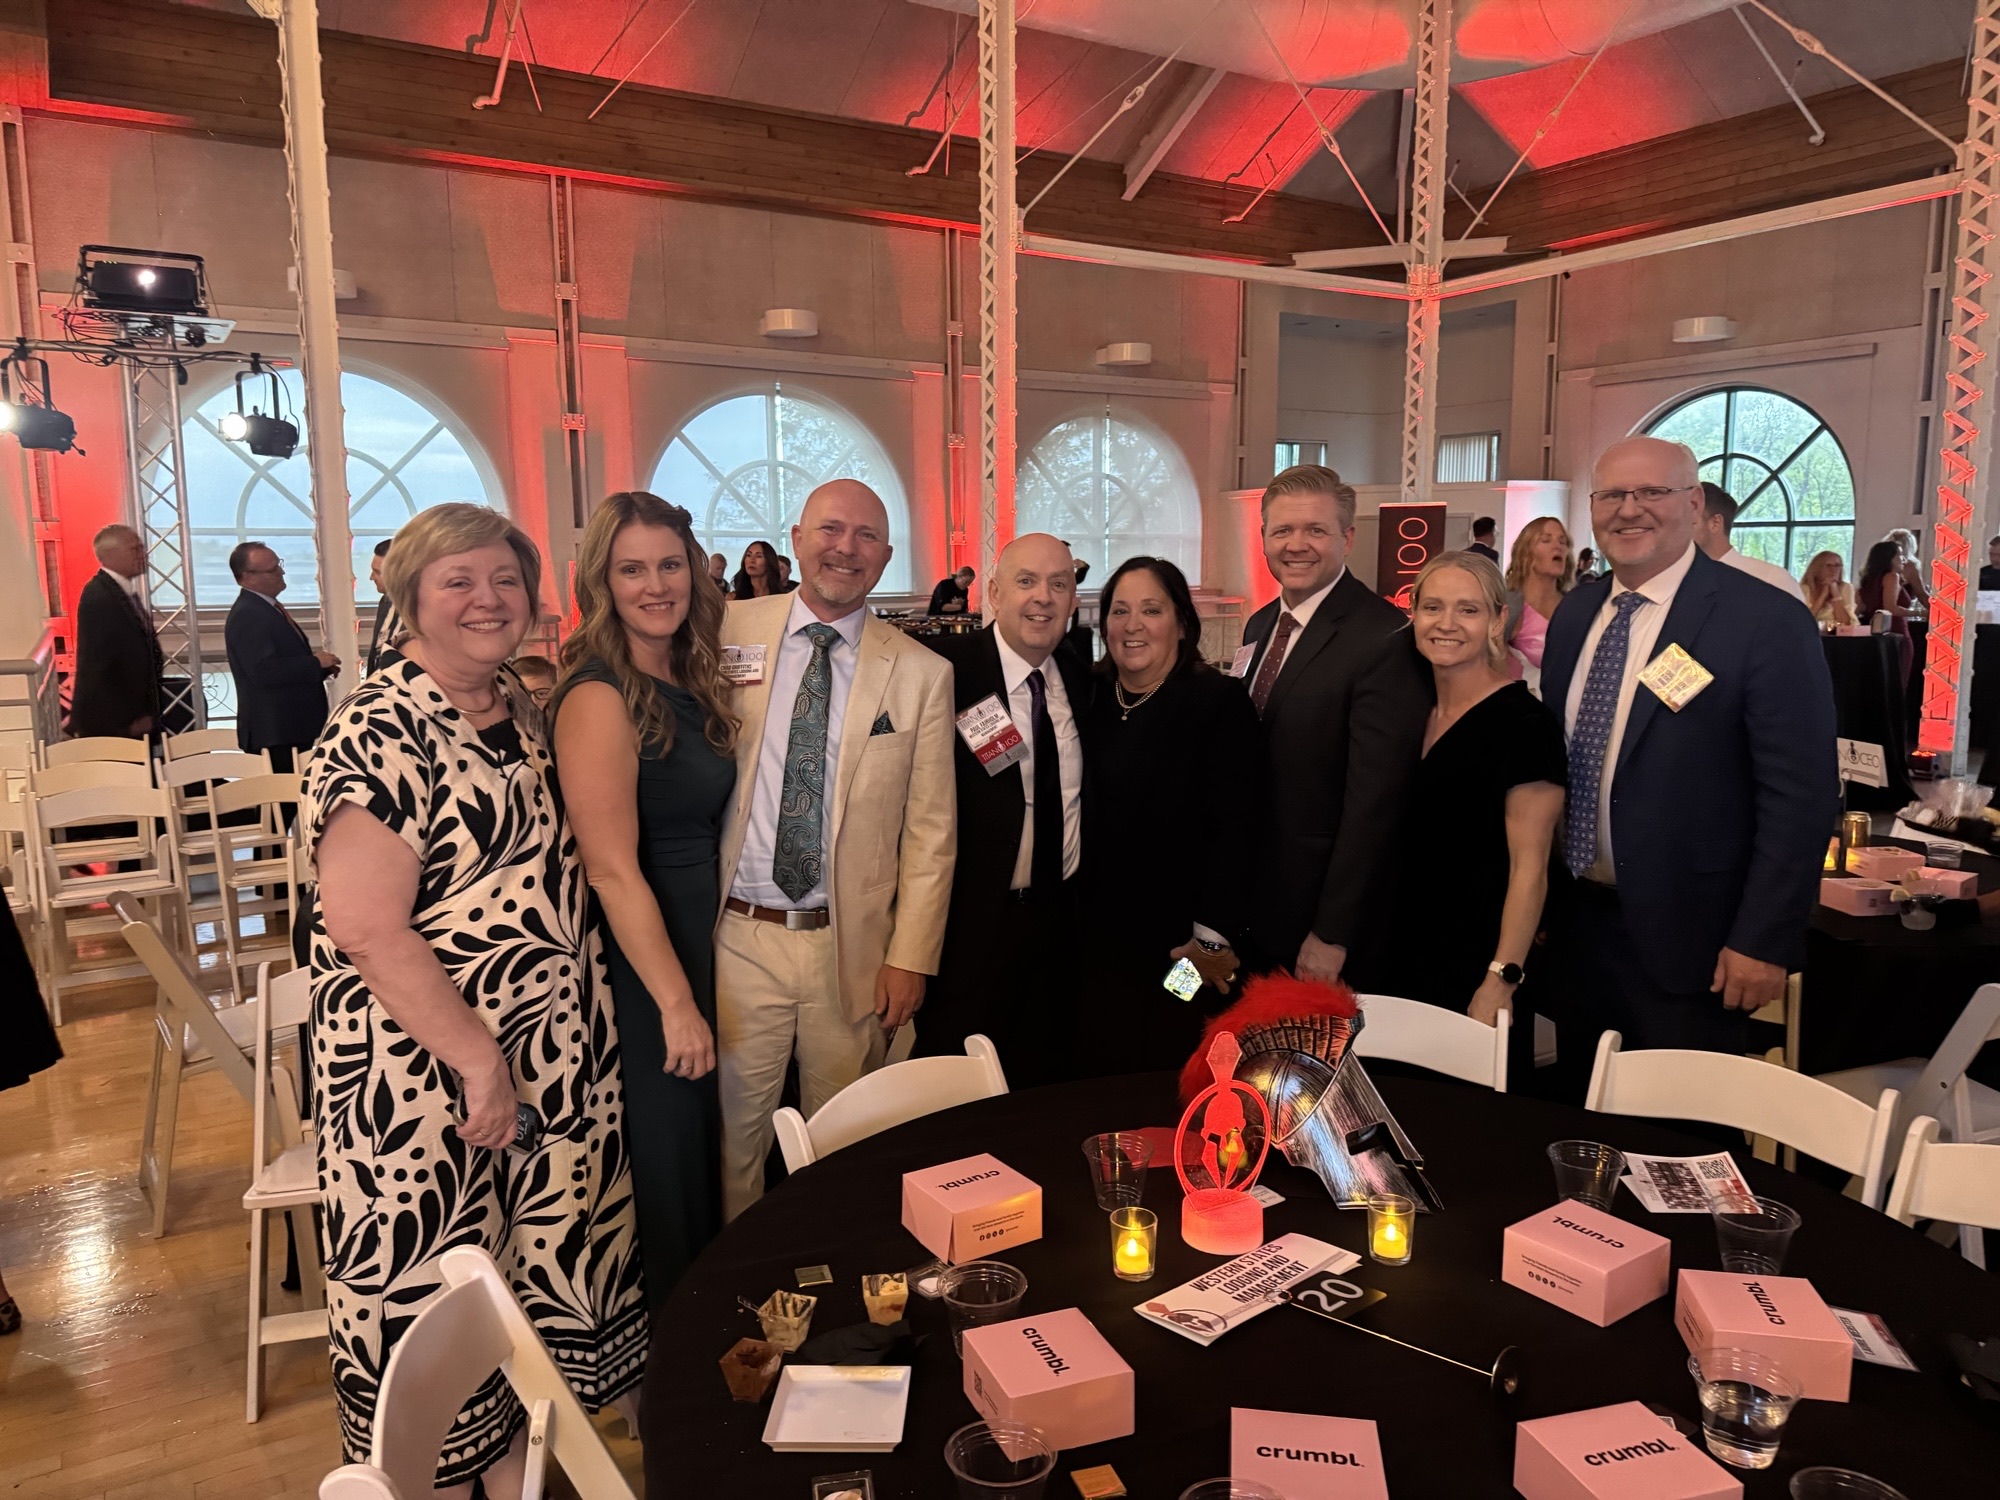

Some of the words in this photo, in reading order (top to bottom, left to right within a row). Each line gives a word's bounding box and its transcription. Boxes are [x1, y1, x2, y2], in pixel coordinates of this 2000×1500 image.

[1397, 517, 1428, 574] 100
[746, 652, 762, 661] 100
[986, 701, 1000, 713] 100
[982, 747, 1000, 761] TITAN
[1005, 735, 1019, 746] 100
[1860, 752, 1880, 768] CEO
[937, 1170, 1001, 1191] crumbl
[1552, 1215, 1625, 1249] crumbl
[1189, 1262, 1247, 1292] WESTERN
[1239, 1244, 1283, 1266] STATES
[1217, 1266, 1268, 1295] LODGING
[1261, 1254, 1290, 1271] AND
[1231, 1260, 1309, 1303] MANAGEMENT
[1297, 1278, 1364, 1312] 20
[1742, 1281, 1786, 1326] crumbl
[1022, 1327, 1071, 1375] crumbl
[1256, 1446, 1361, 1467] crumbl
[1584, 1438, 1677, 1466] crumbl
